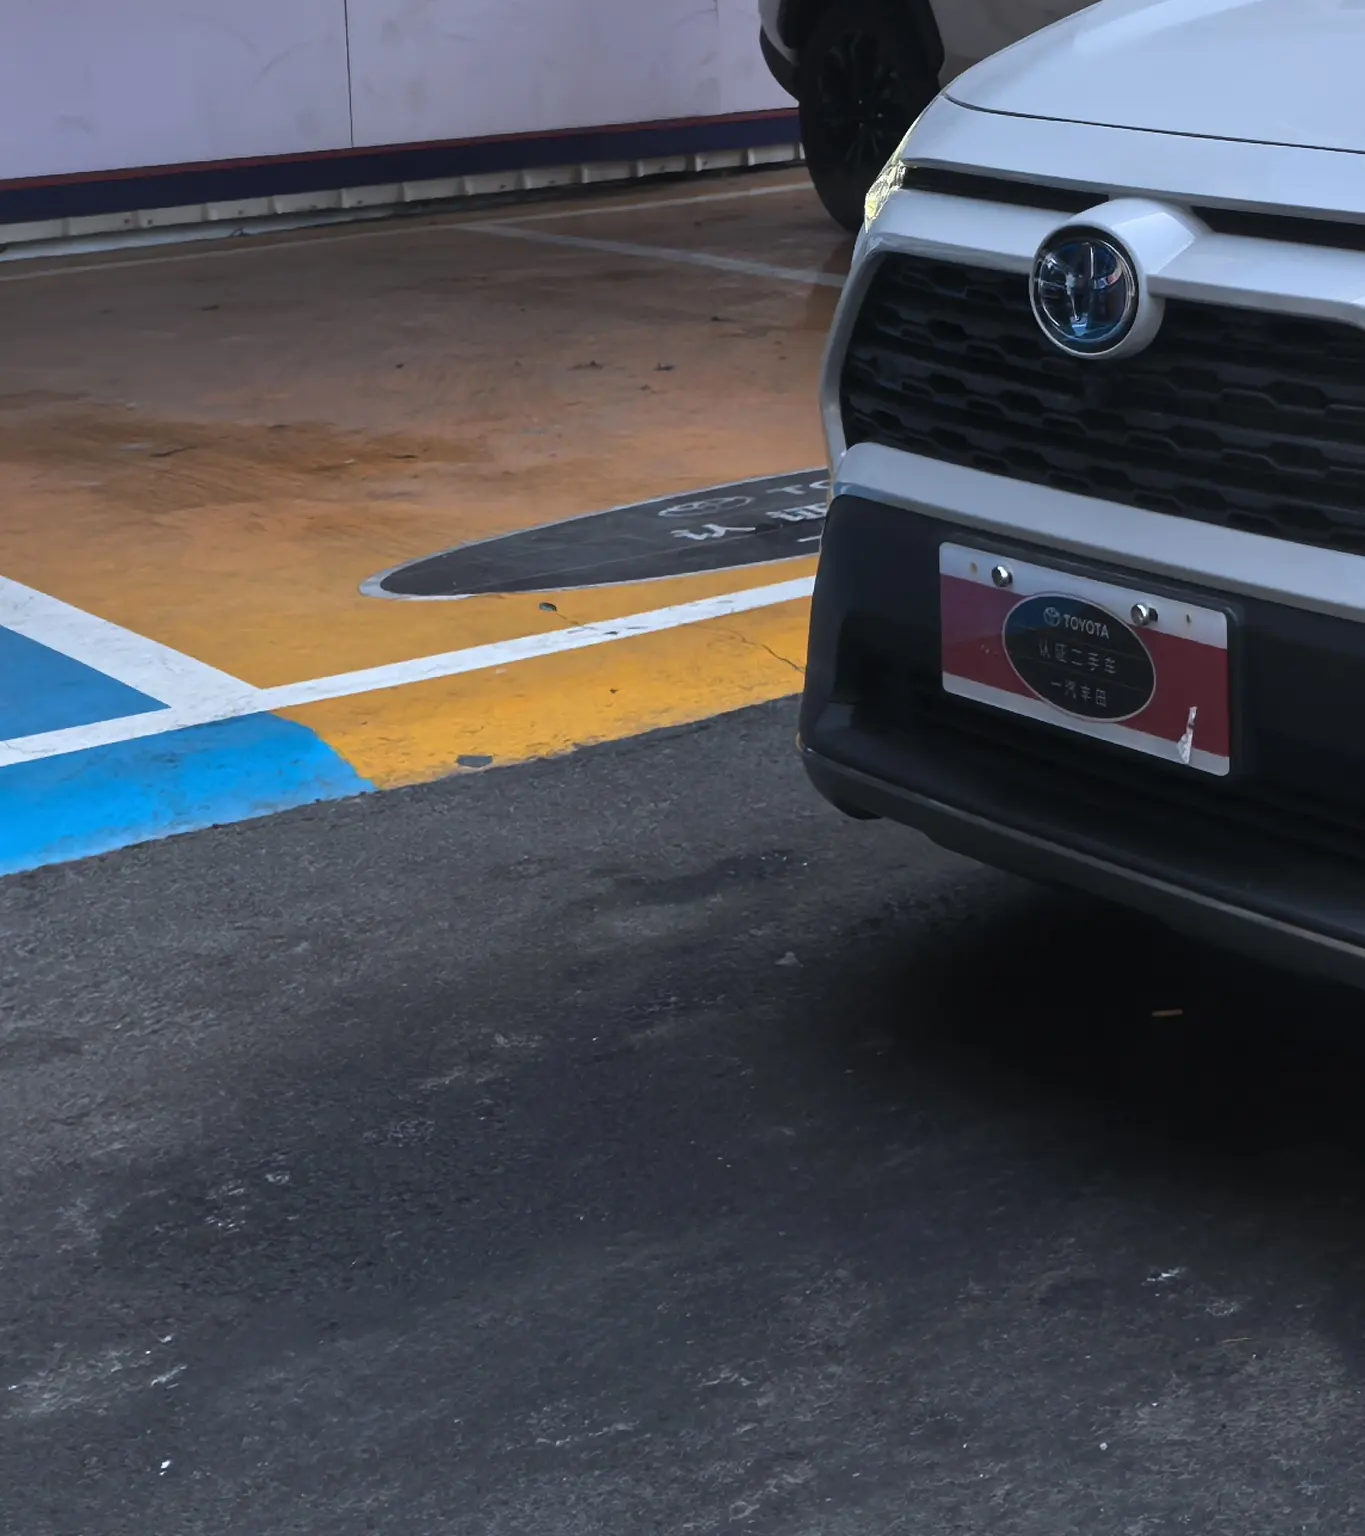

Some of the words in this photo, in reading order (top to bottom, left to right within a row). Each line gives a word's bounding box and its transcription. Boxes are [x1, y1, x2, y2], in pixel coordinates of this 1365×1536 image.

[1062, 613, 1110, 640] TOYOTA
[1038, 638, 1117, 675] 认证二手车
